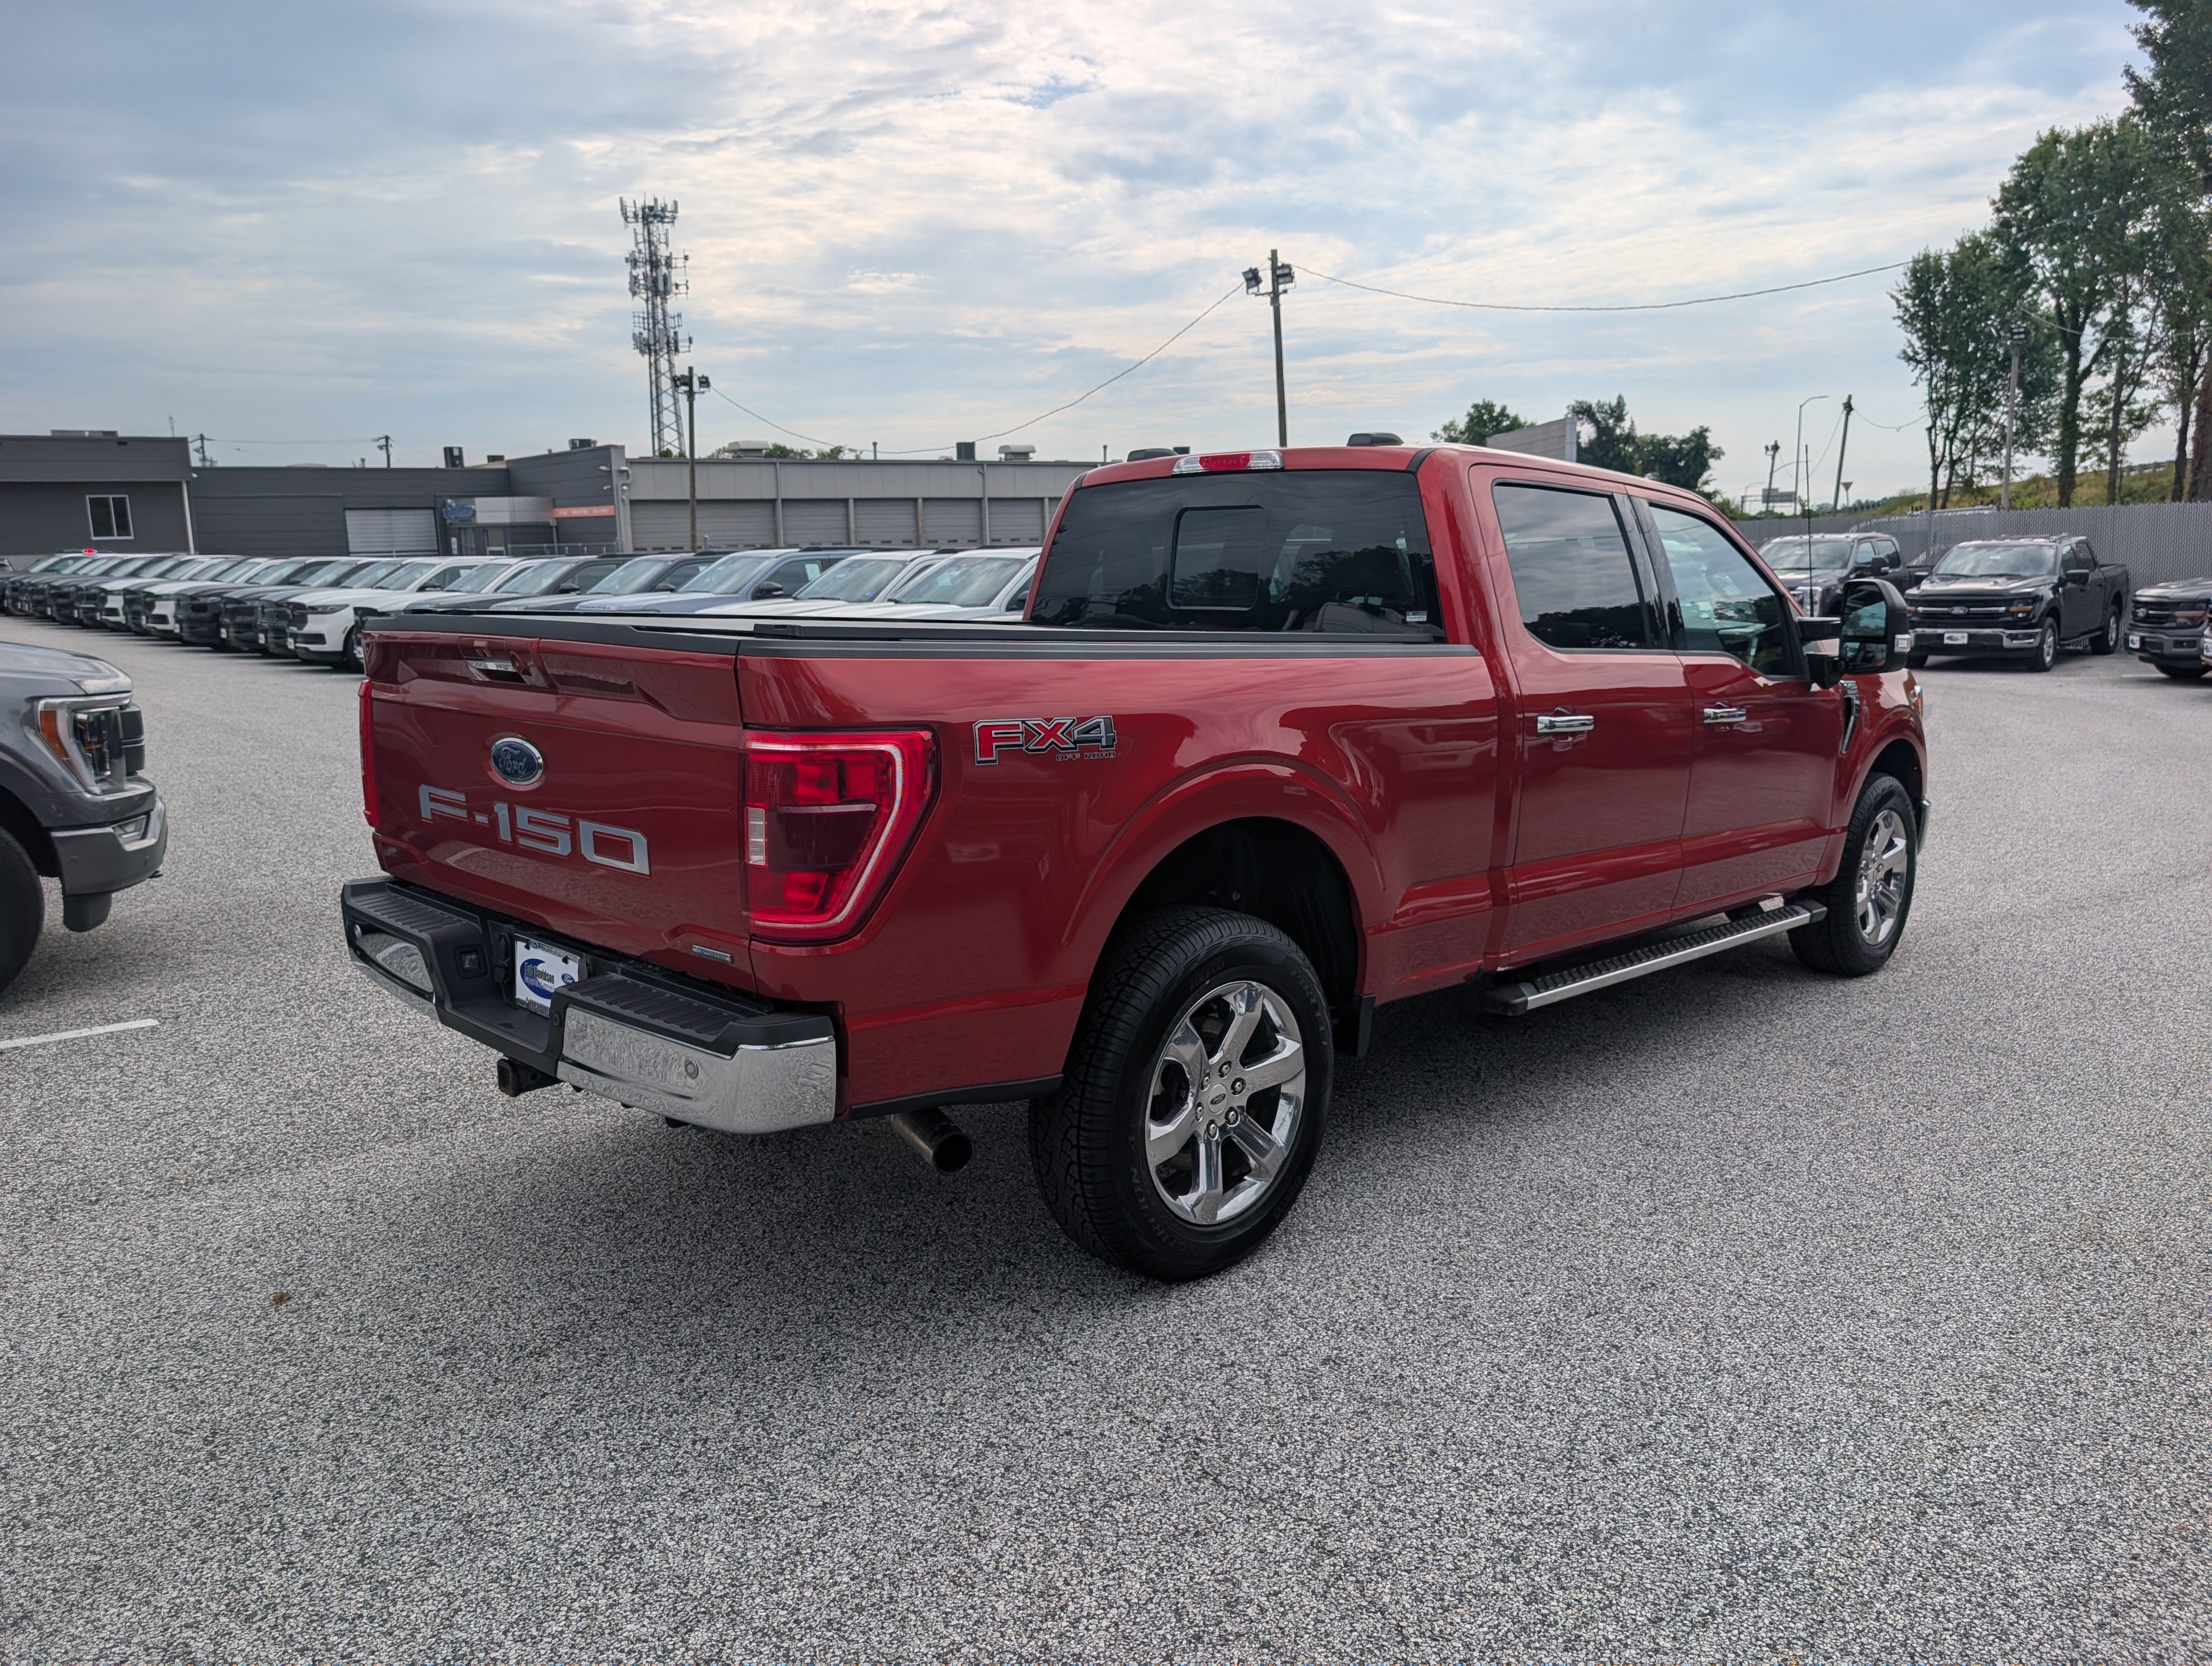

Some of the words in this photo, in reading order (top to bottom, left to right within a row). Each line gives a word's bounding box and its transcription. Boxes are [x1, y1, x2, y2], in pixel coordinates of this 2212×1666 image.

[973, 715, 1117, 765] FX4
[499, 747, 527, 775] Ford
[1056, 753, 1081, 761] OFF
[419, 784, 650, 875] F-150
[525, 962, 534, 976] Bob
[534, 965, 554, 984] Davidson
